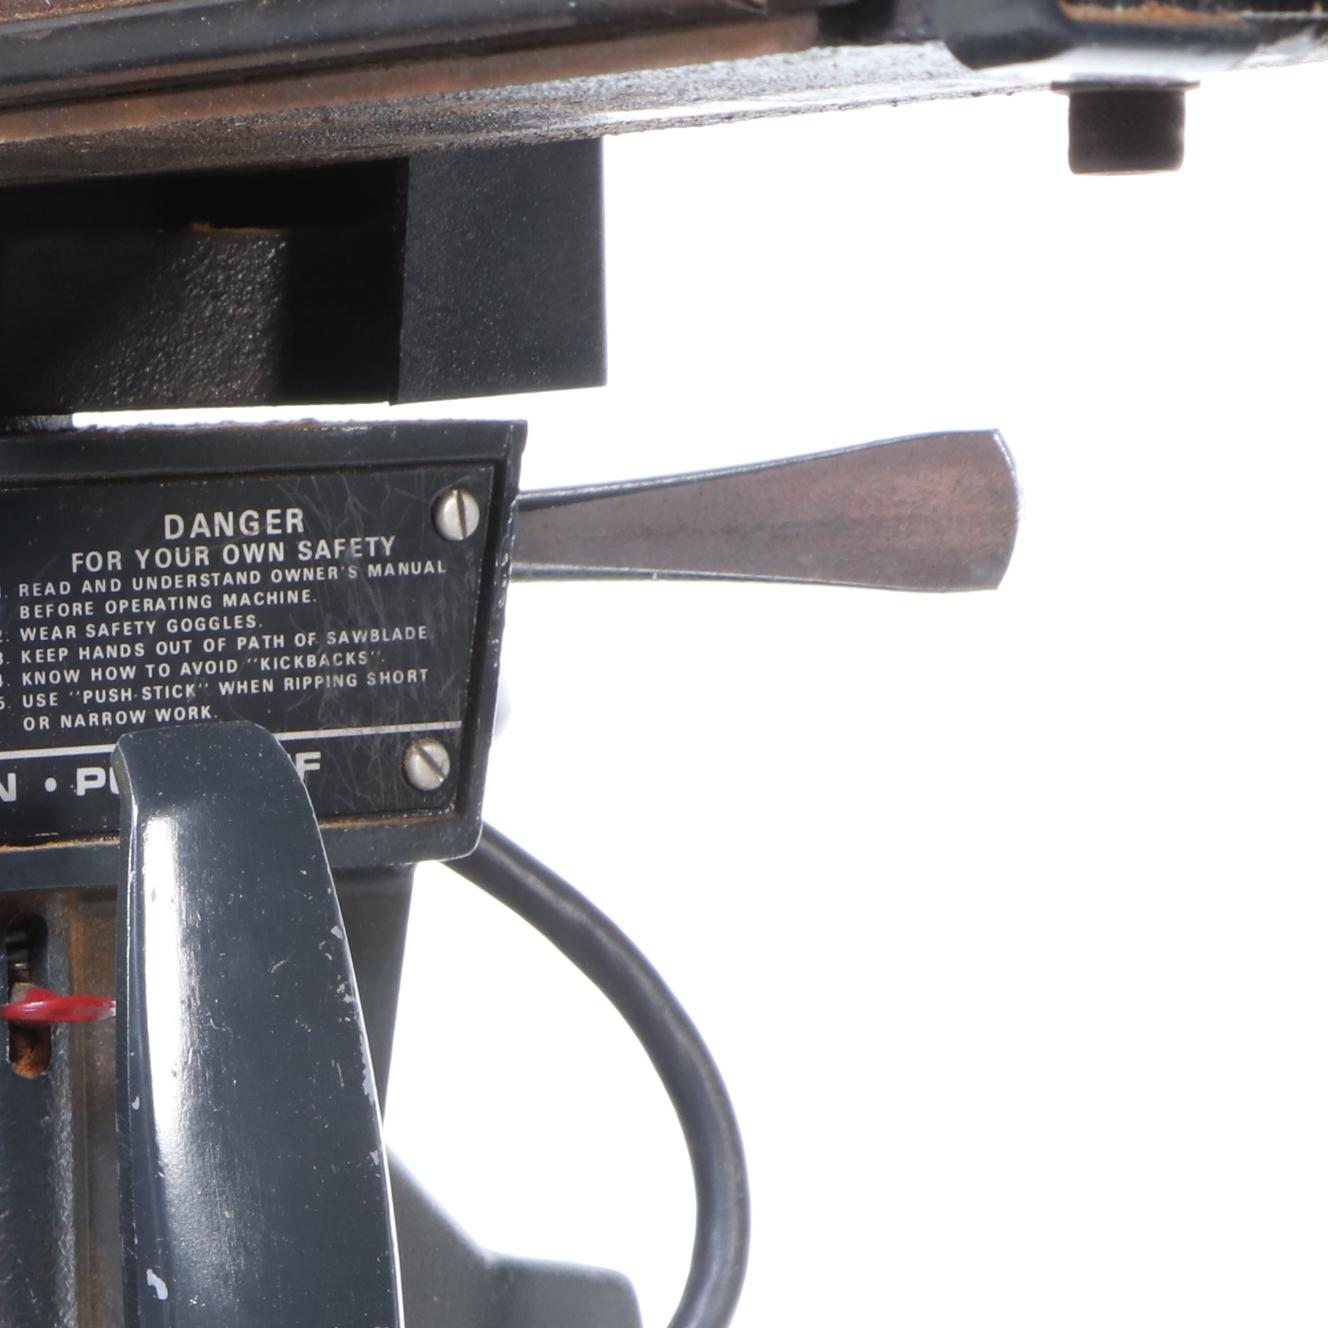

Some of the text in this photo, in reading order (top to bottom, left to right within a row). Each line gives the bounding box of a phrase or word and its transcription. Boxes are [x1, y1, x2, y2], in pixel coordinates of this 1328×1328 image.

[164, 508, 304, 540] DANGER
[72, 535, 396, 573] FOR YOUR OWN SAFETY
[19, 581, 71, 597] READ
[81, 578, 122, 593] AND
[132, 571, 262, 591] UNDERSTAND
[271, 565, 358, 583] OWNER'S
[368, 559, 447, 578] MANUAL
[20, 588, 318, 619] BEFORE OPERATING MACHINE.
[20, 625, 77, 641] WEAR
[85, 620, 157, 639] SAFETY
[166, 614, 263, 634] GOGGLES.
[21, 647, 69, 664] KEEP
[79, 643, 145, 660] HANDS
[156, 640, 192, 656] OUT
[203, 637, 227, 653] OF
[237, 634, 284, 651] PATH
[294, 632, 317, 647] OF
[22, 669, 80, 686] KNOW
[91, 665, 136, 682] HOW
[145, 663, 170, 678] TO
[180, 659, 239, 676] AVOID
[22, 692, 59, 708] USE
[219, 677, 274, 696] WHEN
[284, 672, 358, 691] RIPPING
[367, 668, 429, 686] SHORT
[23, 704, 219, 731] OR NARROW WORK.
